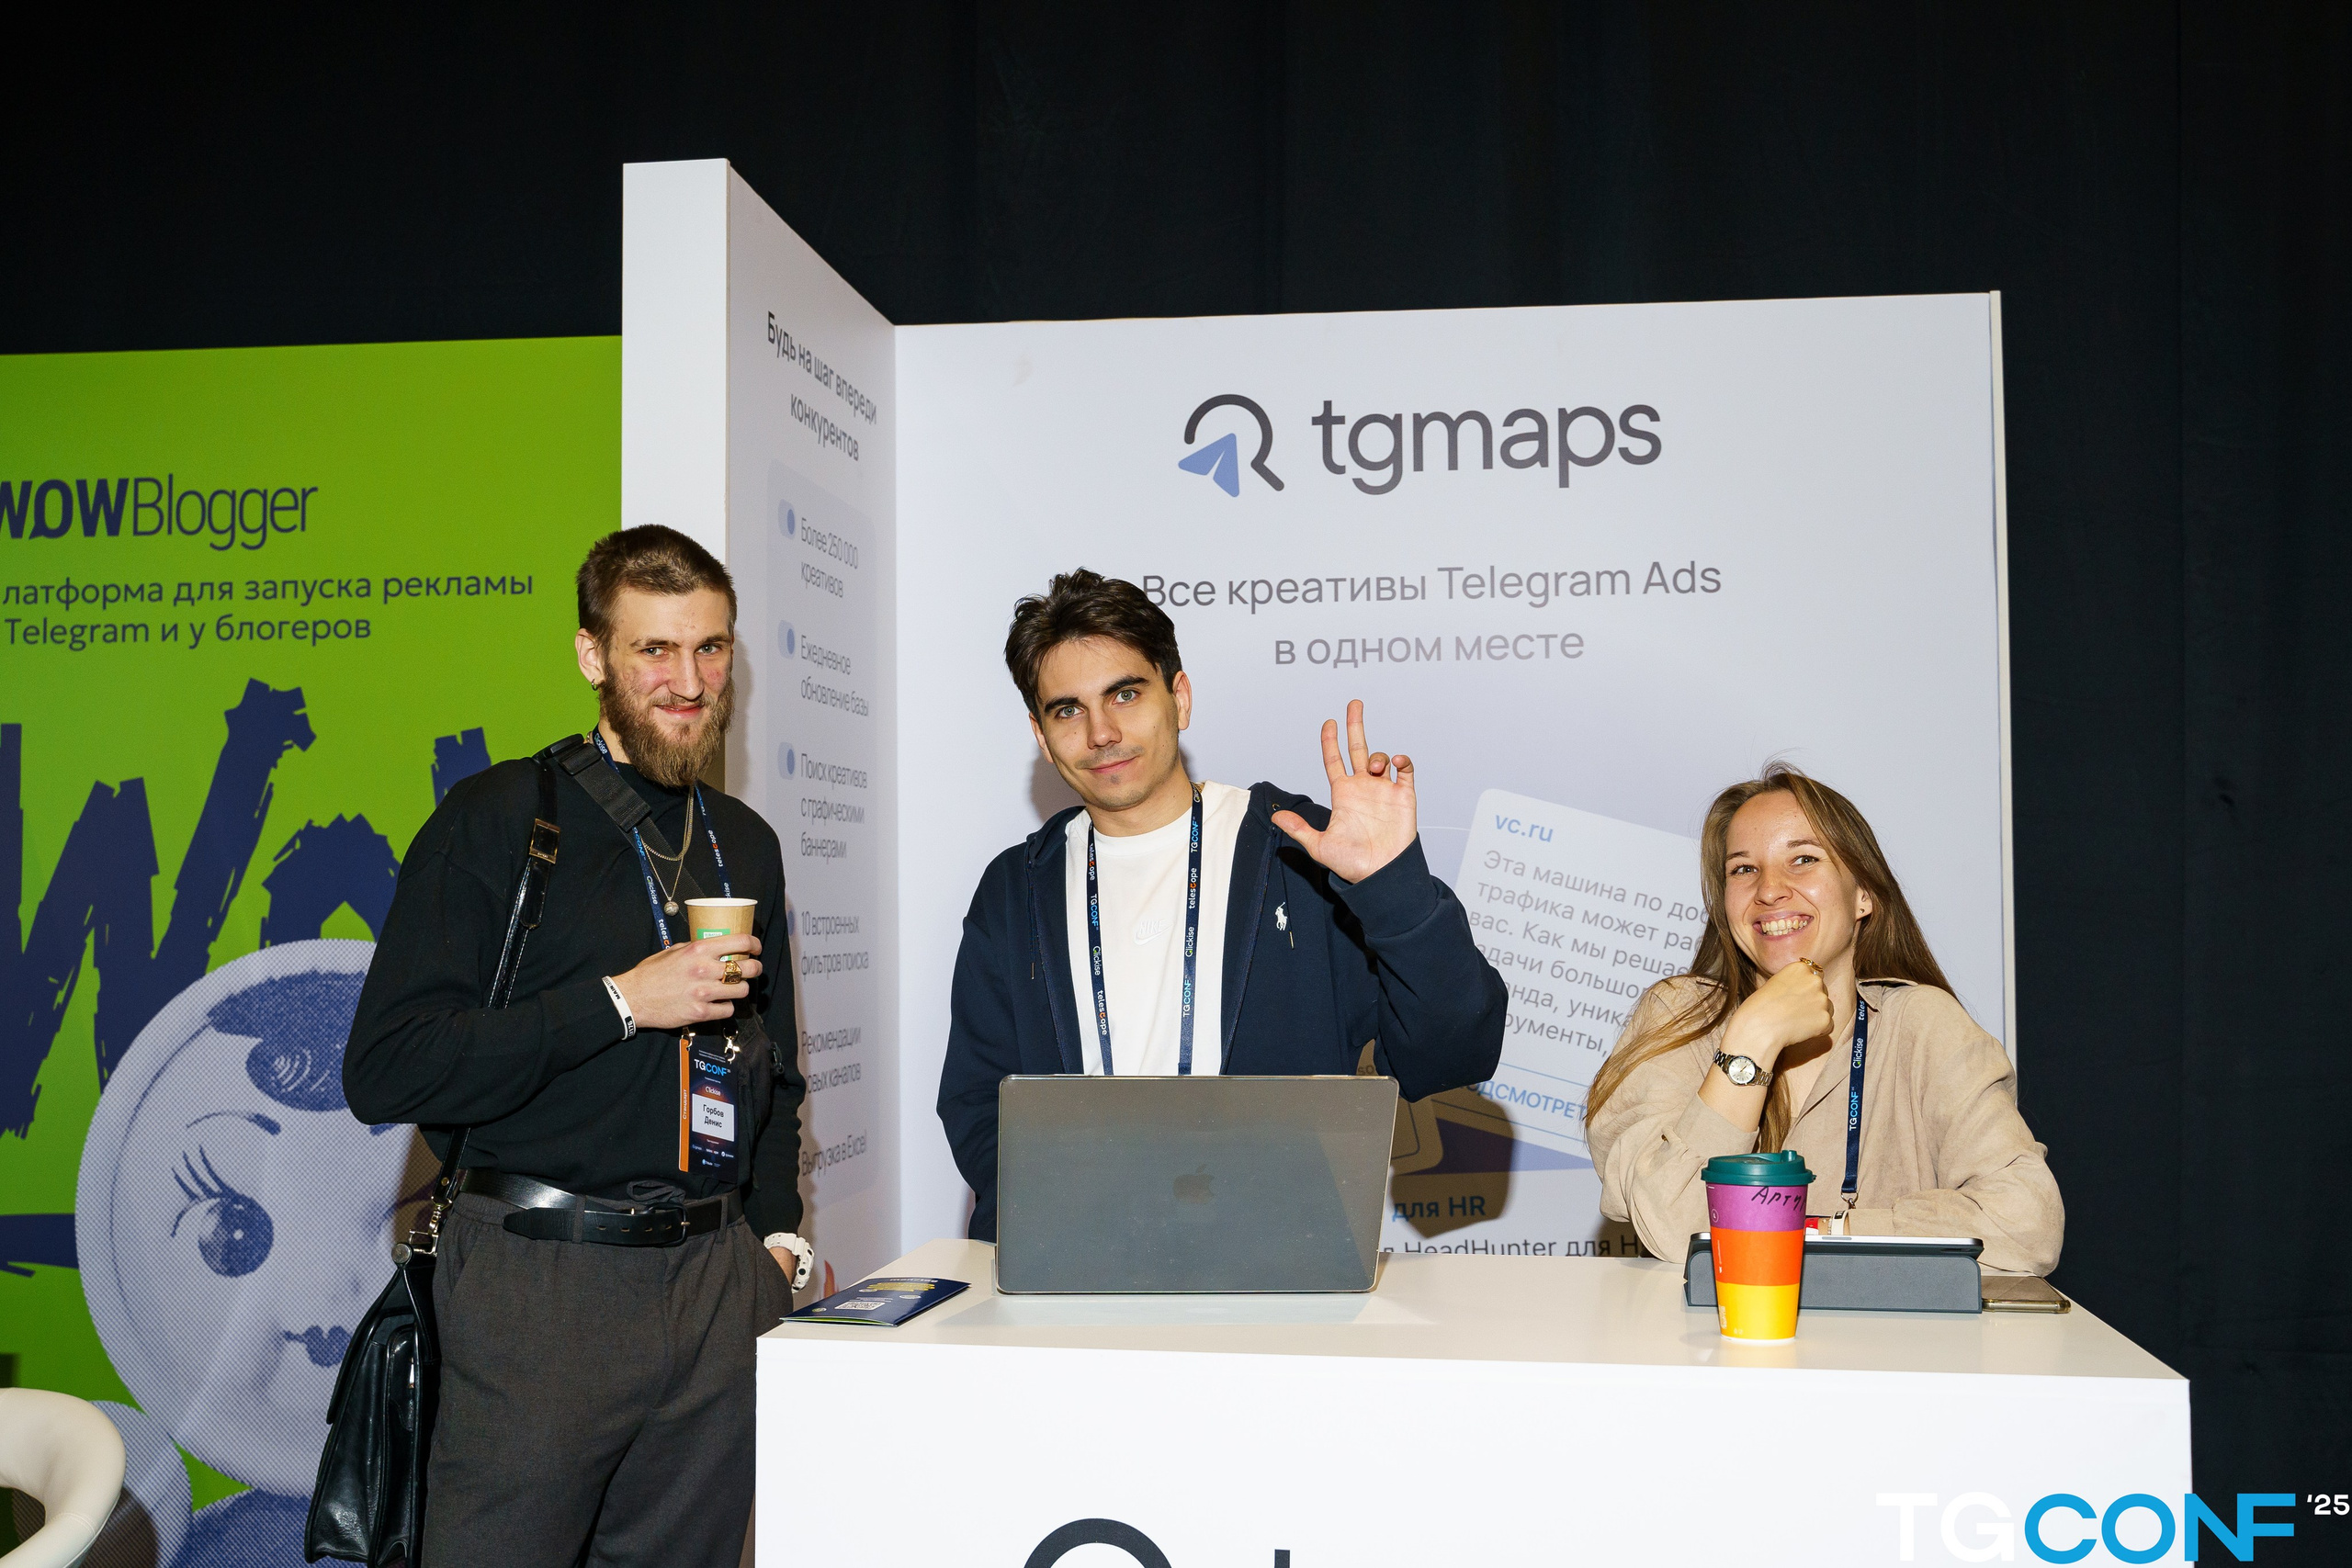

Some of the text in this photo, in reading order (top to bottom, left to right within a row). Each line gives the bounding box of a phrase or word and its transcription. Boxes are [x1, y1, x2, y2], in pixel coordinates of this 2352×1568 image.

[768, 310, 877, 425] Будь на шаг впереди
[790, 392, 859, 461] конкурентов
[1312, 400, 1661, 495] tgmaps
[801, 516, 859, 570] Более 250 000
[3, 574, 533, 612] латформа для запуска рекламы
[801, 560, 843, 598] креативов
[1143, 559, 1722, 615] Все креативы Telegram Ads
[5, 614, 371, 652] Telegram и у блогеров
[1274, 632, 1585, 669] в одном месте
[800, 634, 852, 676] Ежедневное
[800, 675, 869, 717] обновление базы
[801, 752, 868, 790] Поиск креативов
[808, 795, 865, 826] графическими
[1496, 814, 1554, 843] vc.ru
[708, 829, 724, 867] telescope
[800, 831, 847, 865] баннерами
[646, 875, 658, 905] Clickise
[1483, 849, 1526, 877] Эта
[1532, 866, 1627, 903] машина
[1634, 892, 1663, 912] по
[801, 910, 860, 942] 10 встроенных
[1091, 894, 1099, 927] TGCONF
[1183, 820, 1199, 1018] TGCONF Clickise telescope TGCONF
[1476, 881, 1701, 952] трафика может ра
[1470, 911, 1513, 935] вас.
[1522, 920, 1564, 949] Как
[1570, 939, 1606, 960] мы
[801, 950, 869, 982] фильтров поиска
[1092, 945, 1102, 976] Clickise
[1550, 960, 1645, 998] большо
[609, 985, 621, 1000] MAIN
[1505, 981, 1559, 1014] нда,
[1097, 989, 1108, 1036] telescope
[801, 1027, 862, 1056] Рекомендации
[694, 1058, 727, 1076] TGCONF
[807, 1071, 828, 1094] овых
[1849, 999, 1866, 1132] TGCONF Clickise teles
[703, 1104, 725, 1118] Горбов
[704, 1115, 723, 1128] Денис
[801, 1144, 842, 1178] Выгрузка
[1392, 1195, 1487, 1222] для HR
[1565, 1240, 1611, 1257] для
